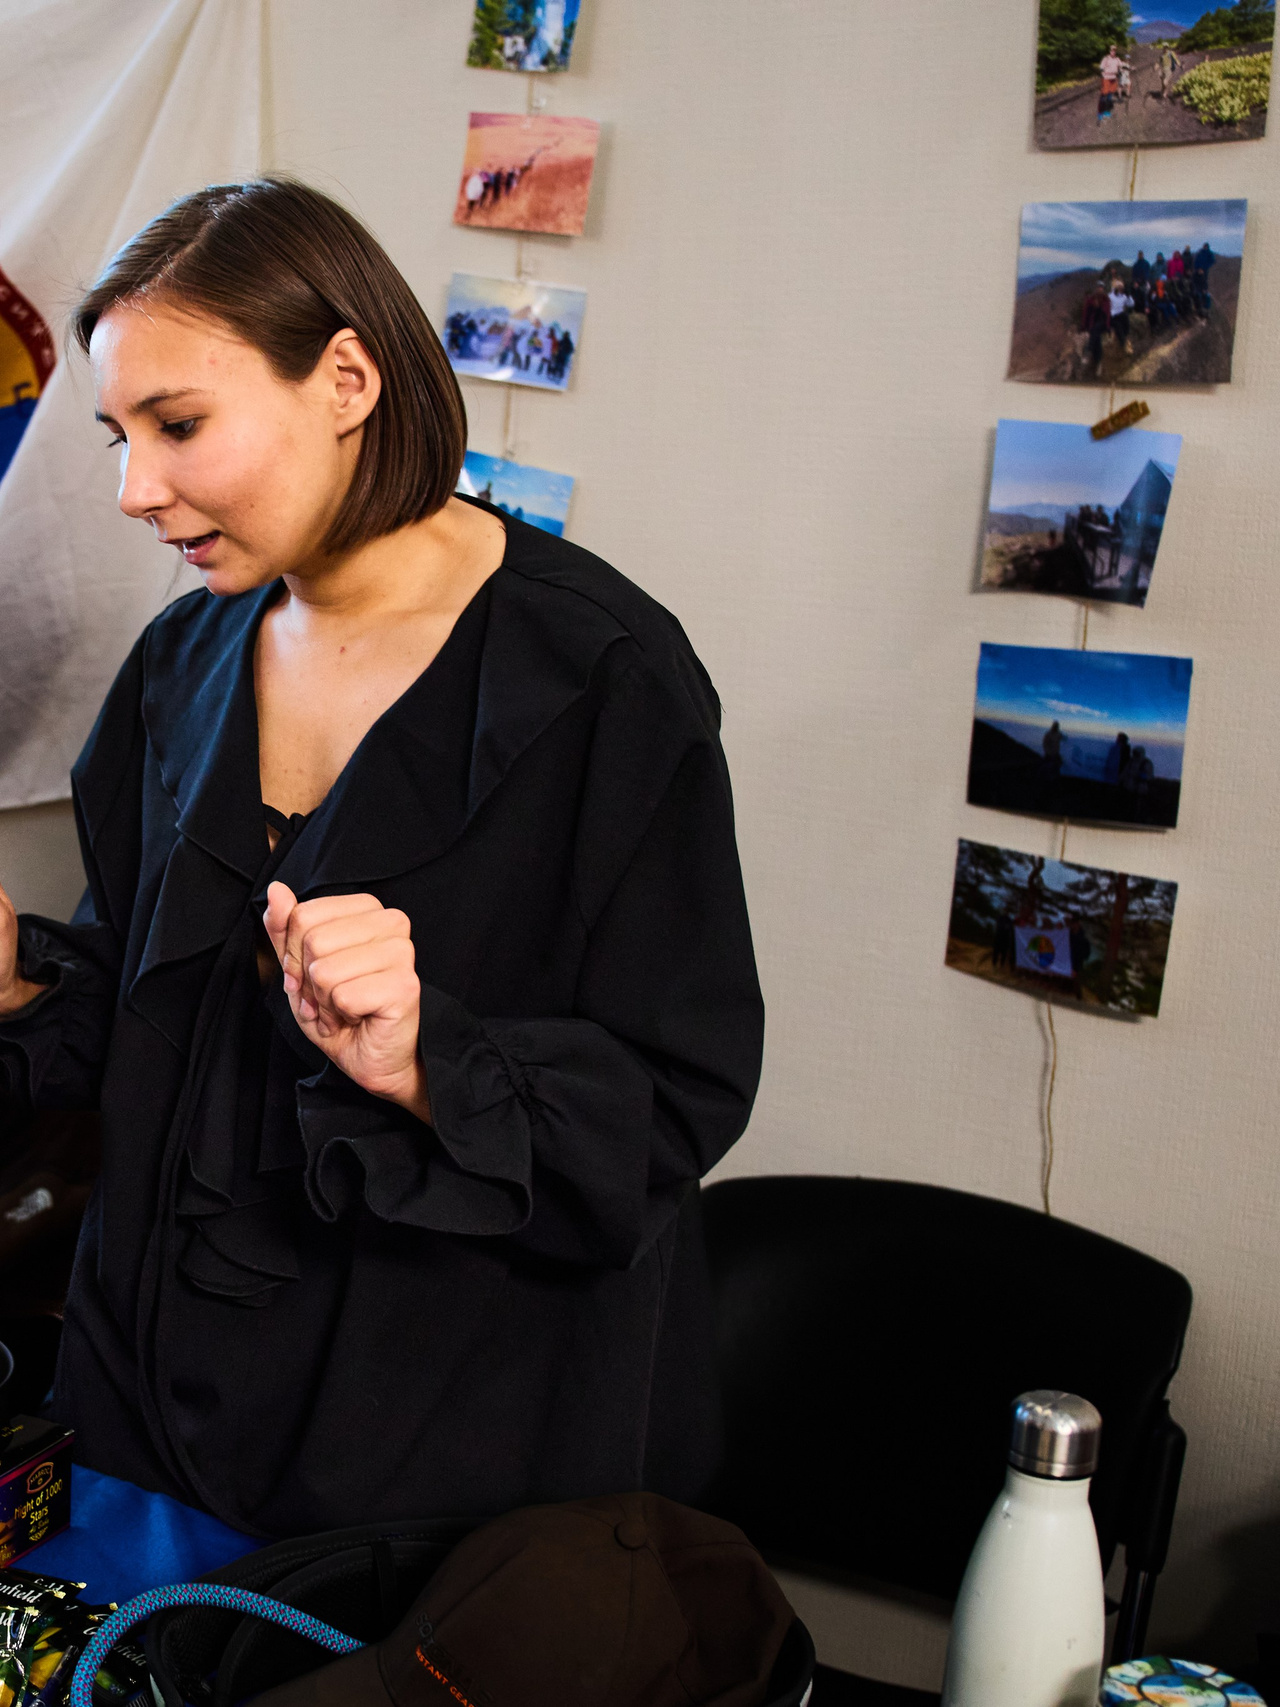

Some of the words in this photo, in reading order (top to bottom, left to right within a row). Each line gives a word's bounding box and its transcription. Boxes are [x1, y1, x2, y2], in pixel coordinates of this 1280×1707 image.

[14, 1498, 35, 1520] Night
[35, 1490, 45, 1507] of
[45, 1478, 63, 1501] 1000
[29, 1505, 49, 1526] Stars
